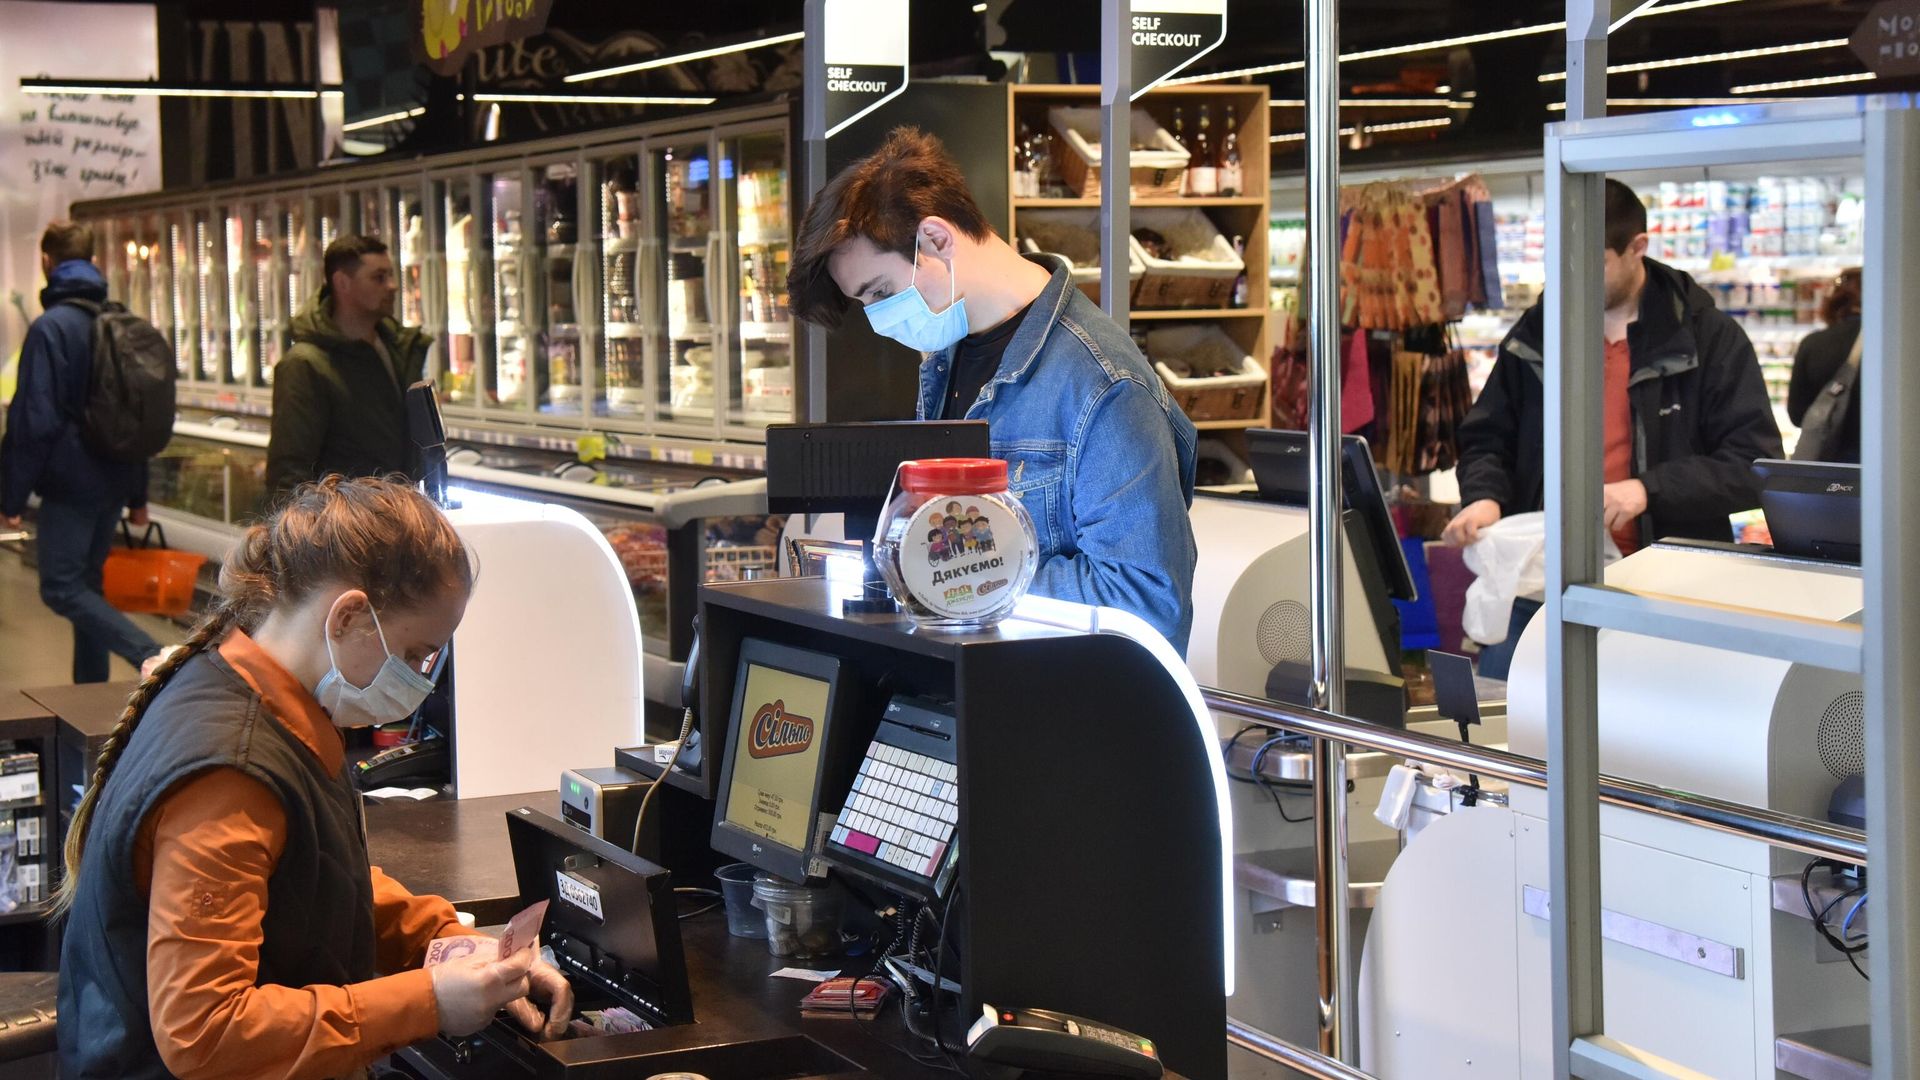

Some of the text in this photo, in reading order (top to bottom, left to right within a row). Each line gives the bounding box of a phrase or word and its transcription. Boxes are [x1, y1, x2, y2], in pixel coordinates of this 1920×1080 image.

[1132, 16, 1161, 30] SELF
[1131, 32, 1202, 47] CHECKOUT
[827, 67, 852, 79] SELF
[827, 80, 887, 92] CHECKOUT
[754, 707, 811, 750] Сільпо
